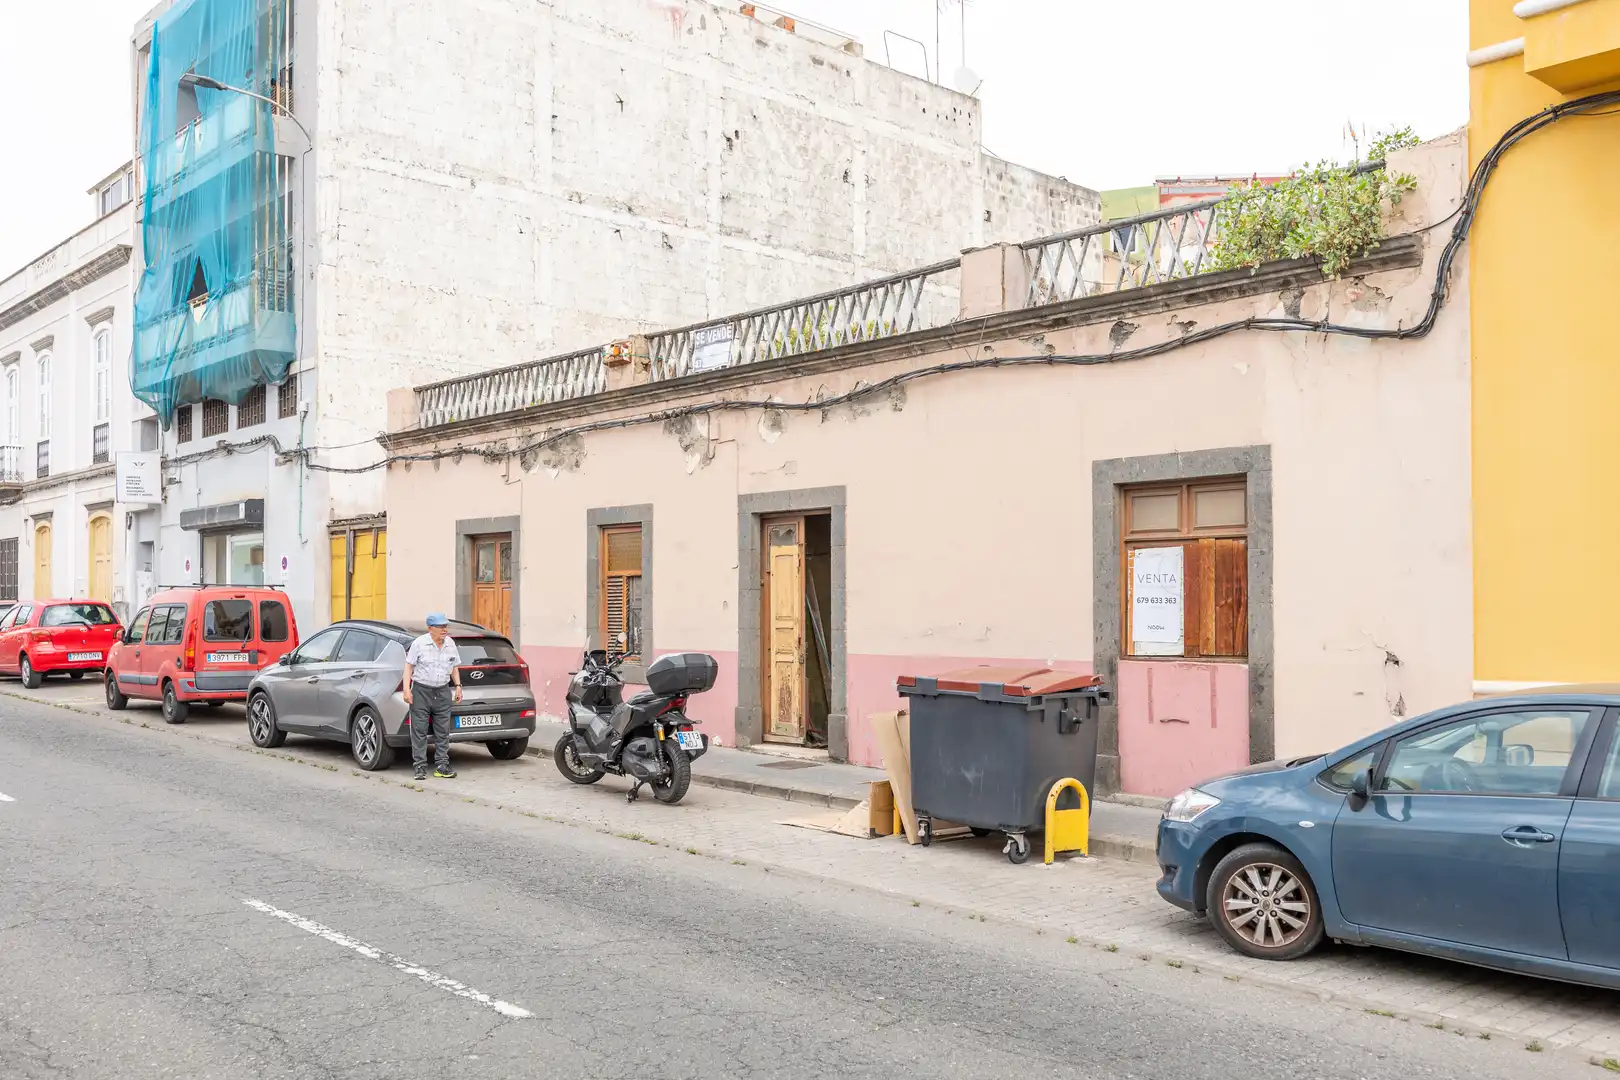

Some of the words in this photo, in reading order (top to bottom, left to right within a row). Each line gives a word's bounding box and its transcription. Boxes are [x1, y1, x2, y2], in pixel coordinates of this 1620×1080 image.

[696, 331, 706, 346] SE
[707, 325, 732, 343] VENDE
[1137, 573, 1177, 584] VENTA
[1136, 596, 1149, 604] 679
[1150, 596, 1163, 604] 633
[1164, 597, 1177, 605] 363
[461, 716, 482, 726] 6828
[484, 714, 500, 725] LZX
[683, 732, 700, 741] 5113
